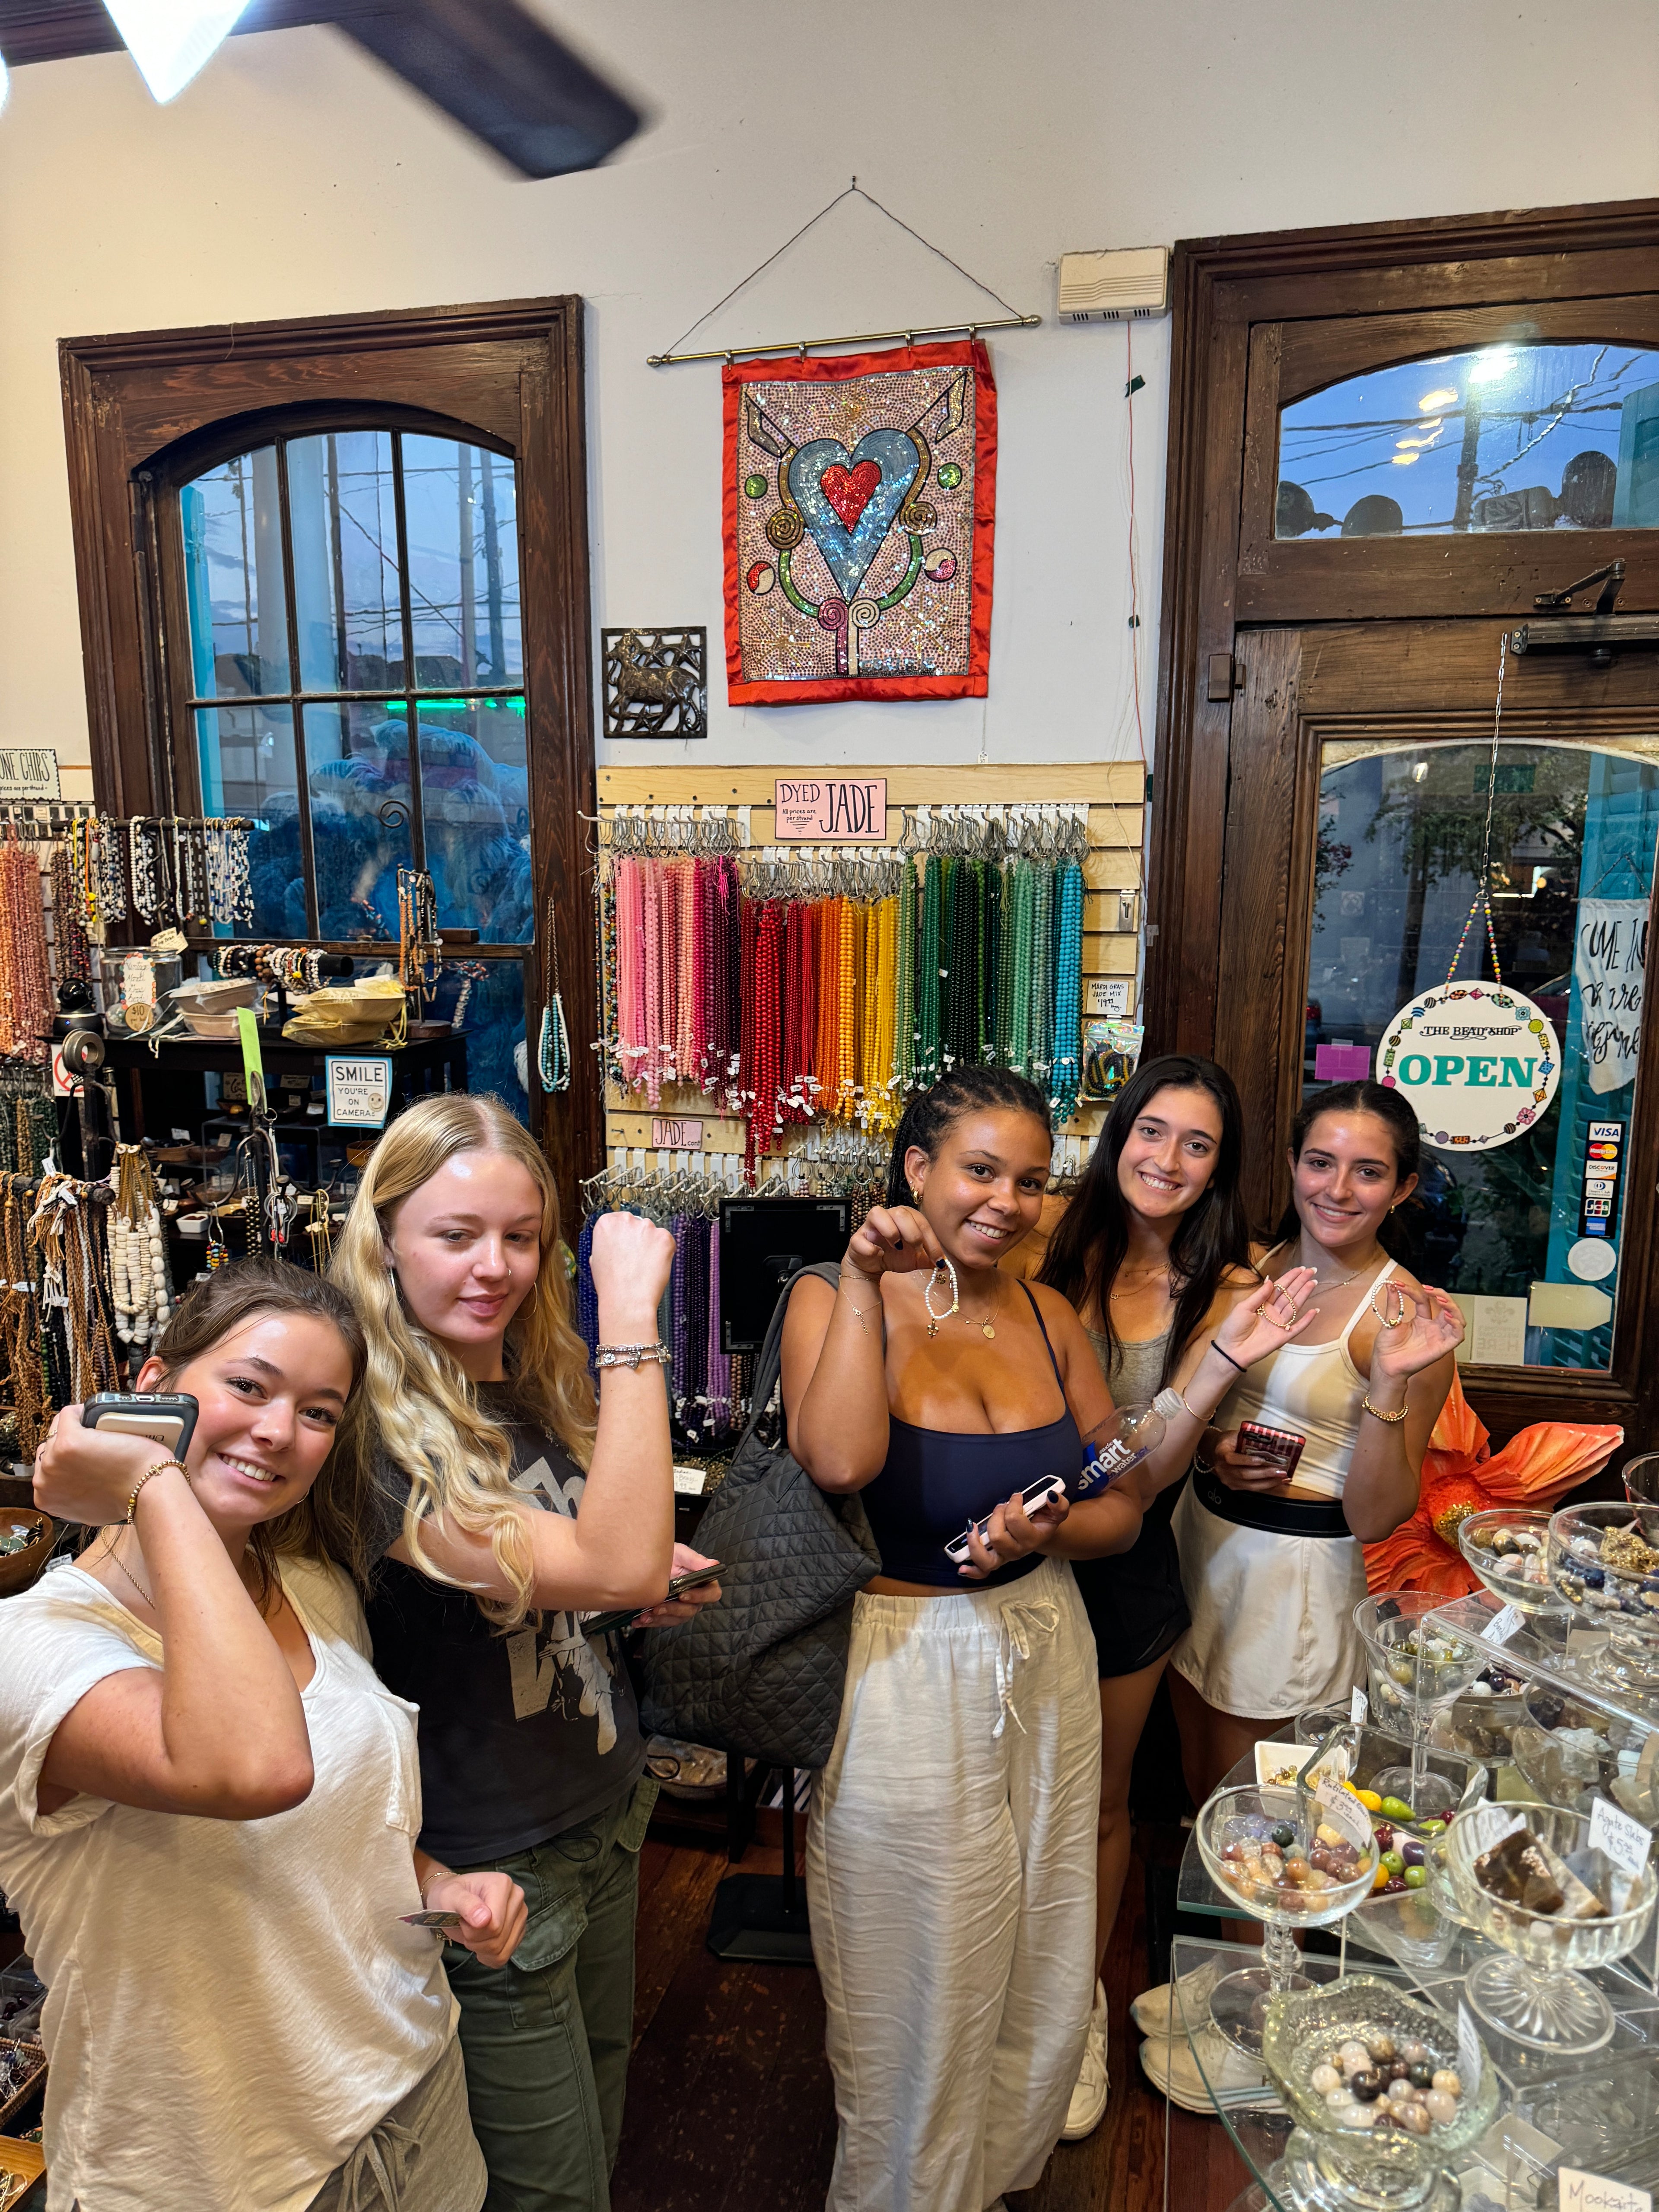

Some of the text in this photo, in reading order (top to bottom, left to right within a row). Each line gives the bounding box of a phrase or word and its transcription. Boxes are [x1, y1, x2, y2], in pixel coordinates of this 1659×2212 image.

[20, 752, 50, 782] CHIPS
[780, 783, 879, 833] DYED JADE
[132, 1005, 145, 1016] $10
[1420, 1025, 1522, 1038] THE BEAD SHOP
[336, 1066, 383, 1082] SMILE
[1398, 1054, 1538, 1088] OPEN
[655, 1120, 686, 1146] JADE
[1594, 1127, 1619, 1137] VISA
[1586, 1200, 1609, 1215] JCB
[1077, 1438, 1131, 1490] smart
[1111, 1452, 1137, 1473] water
[1208, 1487, 1222, 1504] alo
